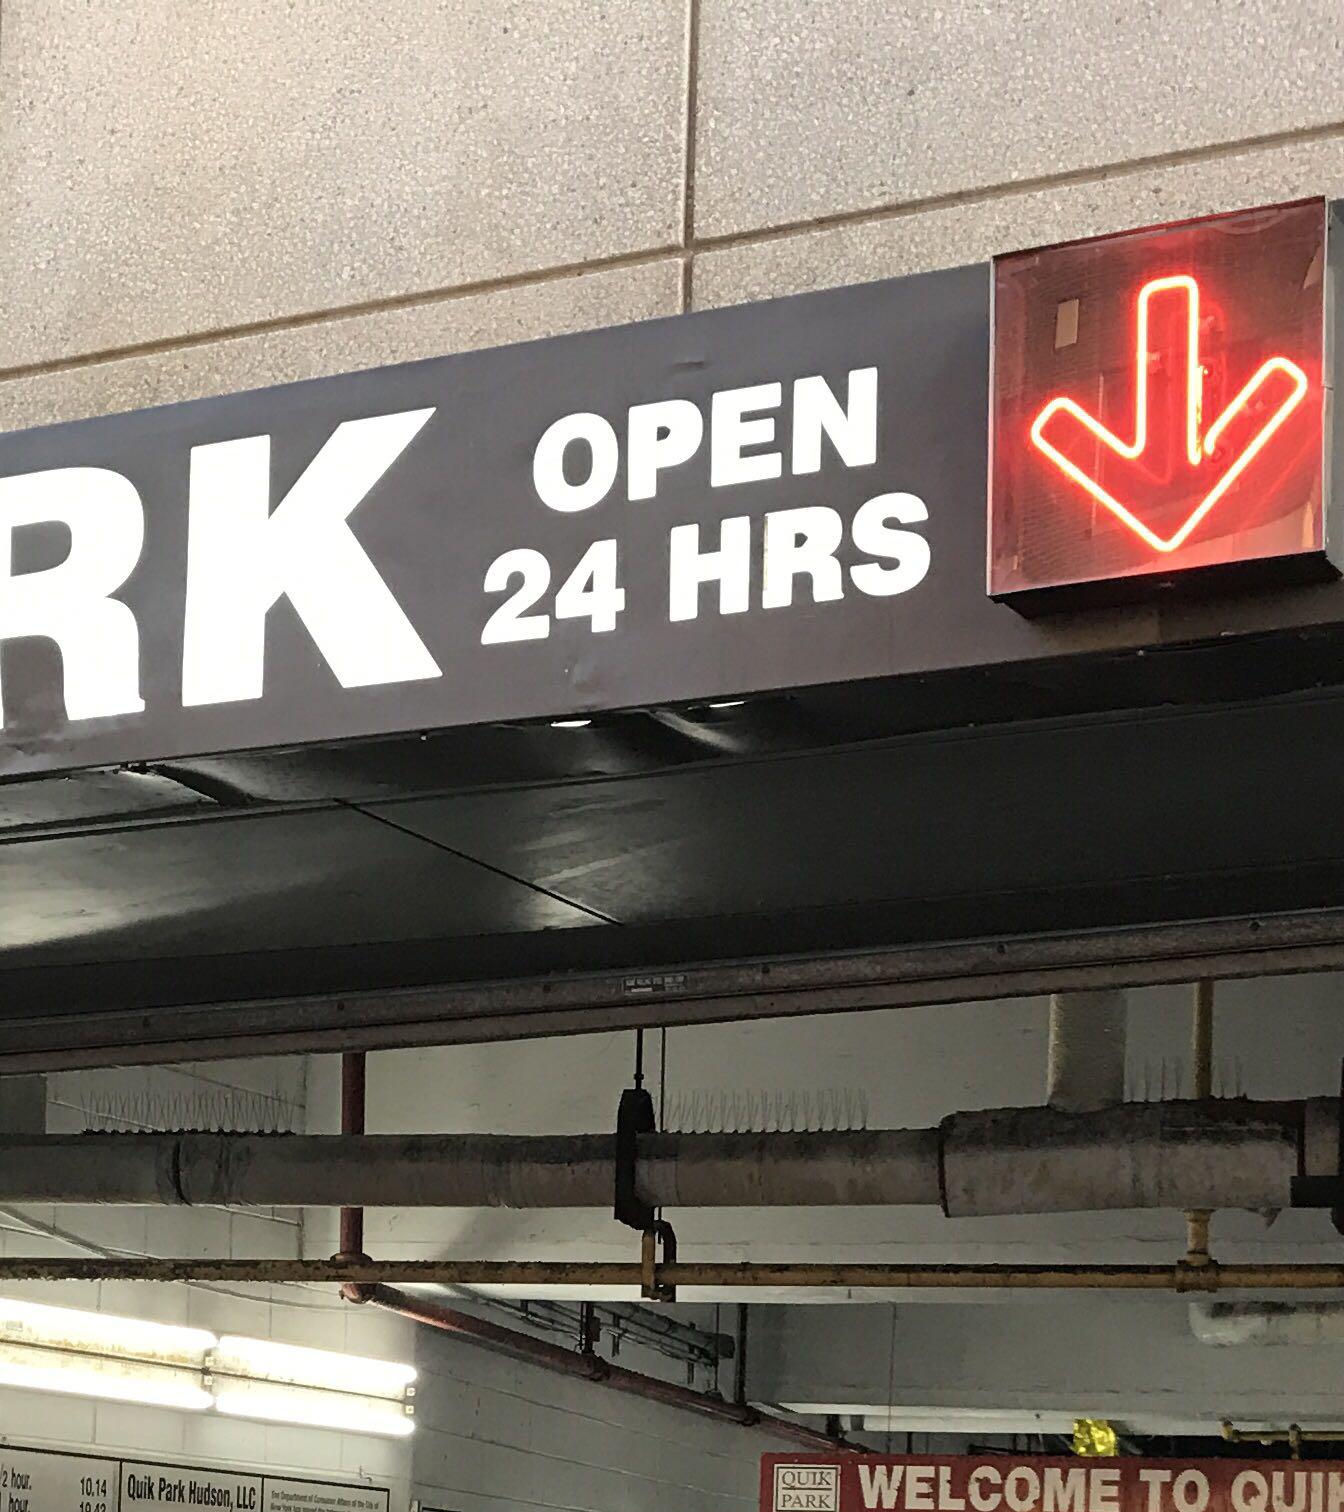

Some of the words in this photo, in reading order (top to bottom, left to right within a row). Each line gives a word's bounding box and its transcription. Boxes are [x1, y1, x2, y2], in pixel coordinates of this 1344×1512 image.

[532, 369, 879, 513] OPEN
[481, 545, 627, 646] 24
[668, 492, 931, 621] HRS
[80, 1477, 106, 1497] 10.14
[128, 1474, 155, 1500] Quik
[158, 1477, 185, 1503] Park
[189, 1480, 234, 1512] Hudson,
[236, 1485, 256, 1510] LLC
[782, 1470, 832, 1488] QUIK
[782, 1494, 831, 1509] PARK
